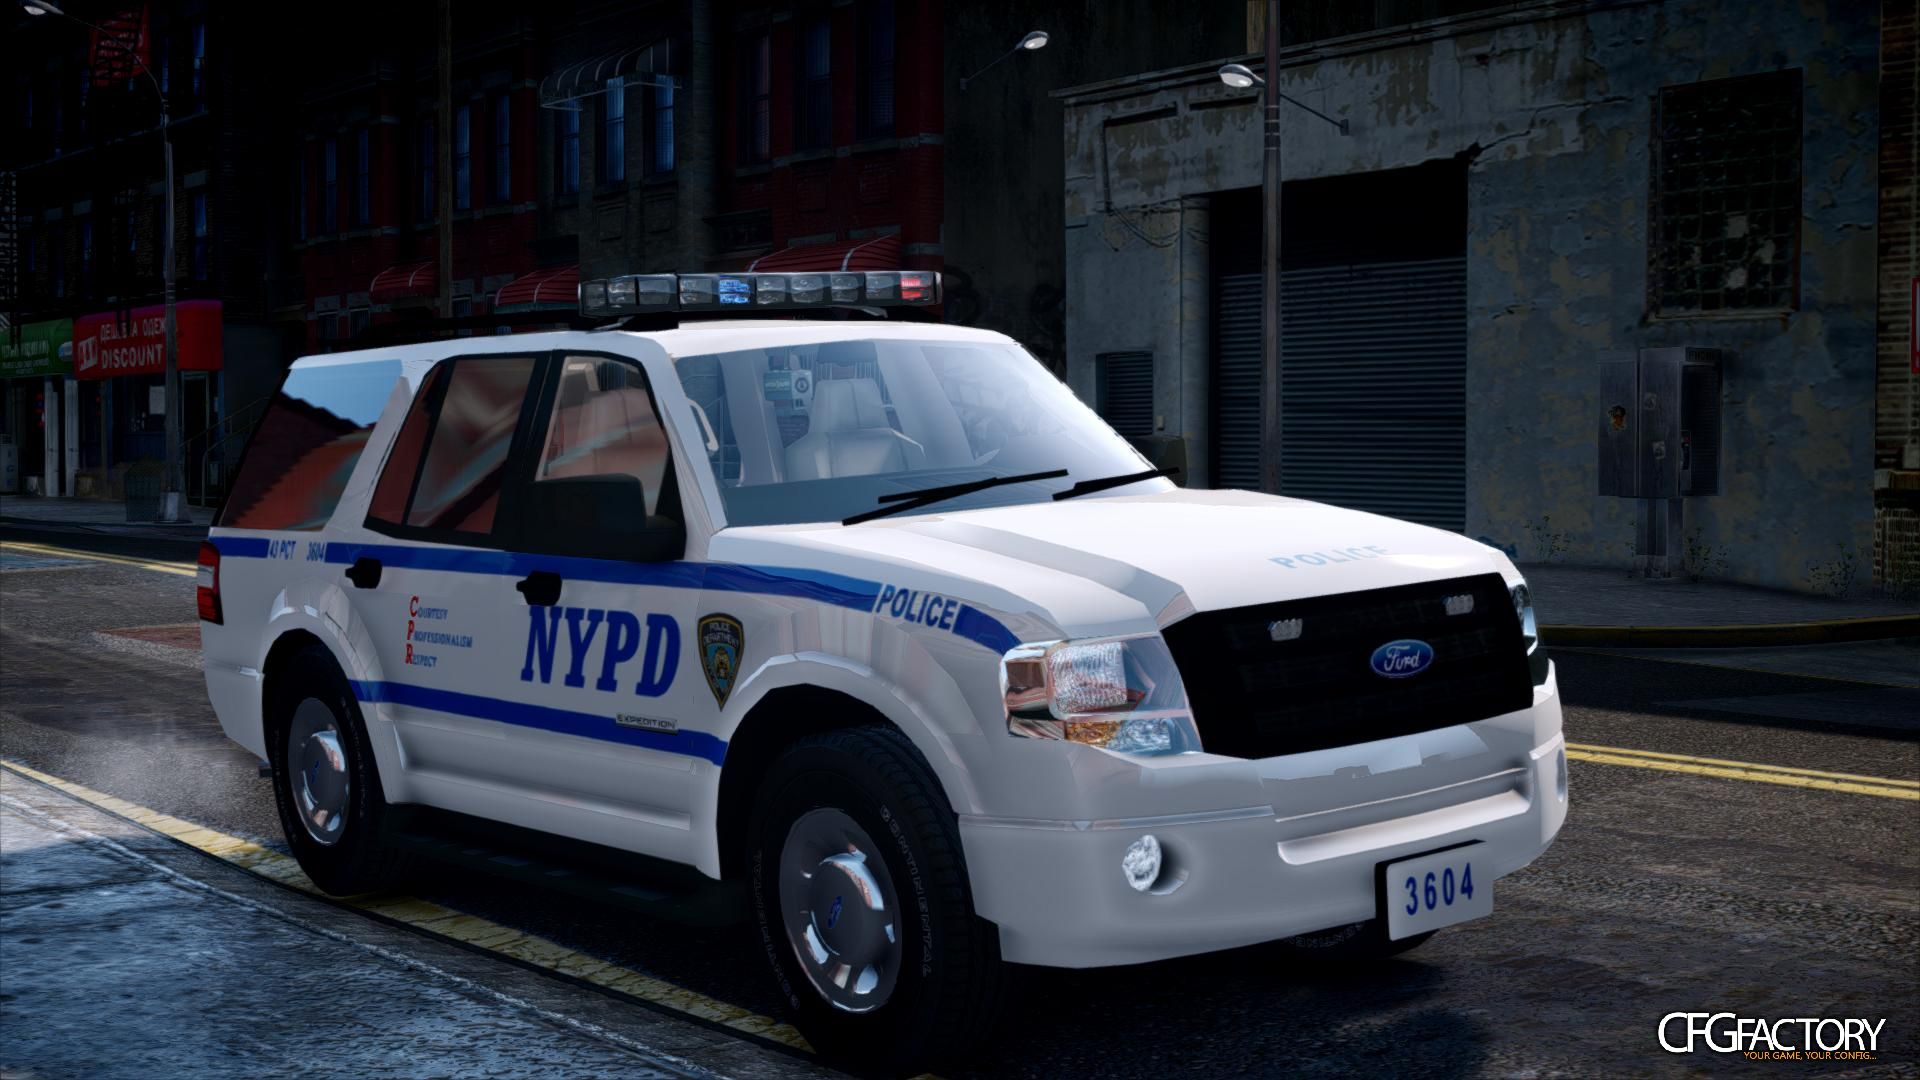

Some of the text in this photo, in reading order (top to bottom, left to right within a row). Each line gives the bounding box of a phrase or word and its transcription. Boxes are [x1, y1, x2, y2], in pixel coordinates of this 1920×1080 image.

[101, 343, 163, 369] DISCOUNT
[279, 540, 296, 560] PCT
[1267, 545, 1389, 569] POLICE
[876, 583, 959, 631] POLICE
[407, 620, 474, 648] PROFESSIONALISM
[405, 643, 438, 667] RESPECT
[521, 605, 681, 697] NYPD
[1383, 644, 1421, 672] Ford
[616, 713, 676, 729] EXPEDITION
[1404, 861, 1474, 916] 3604
